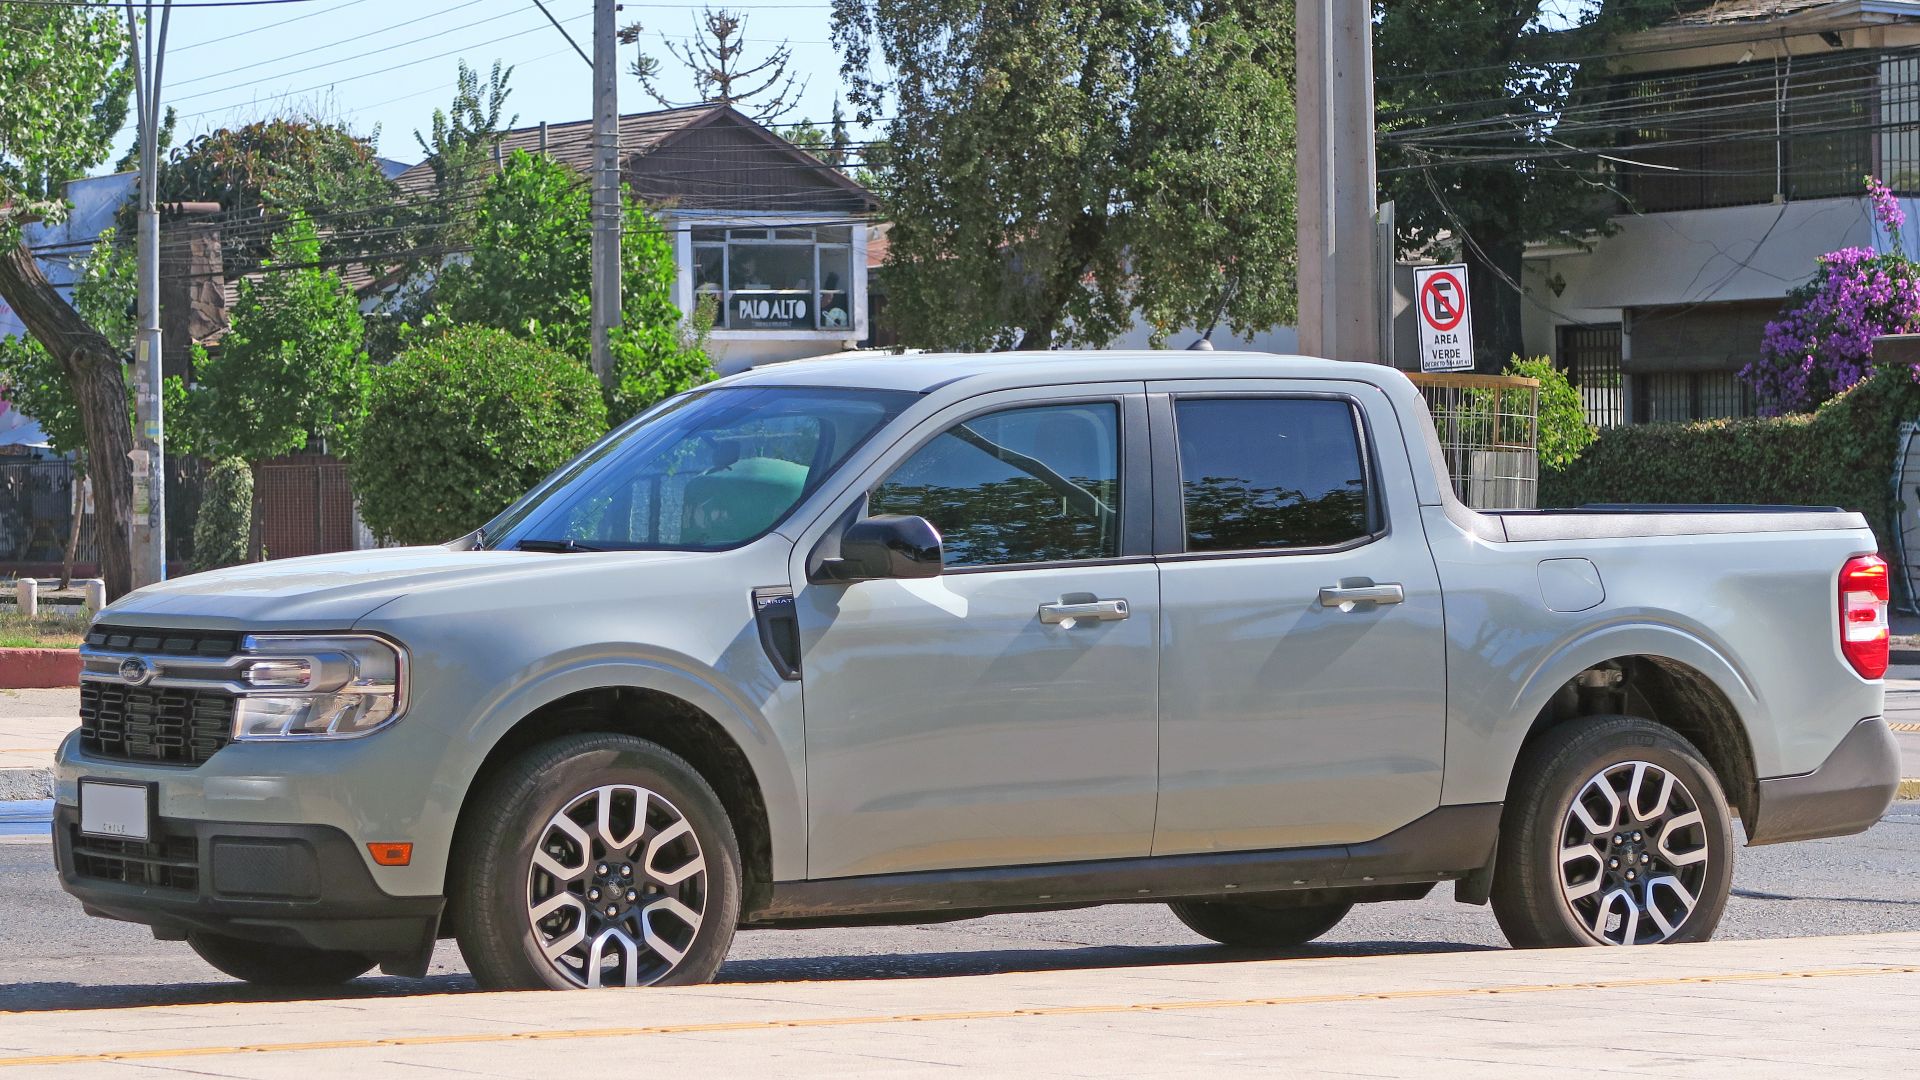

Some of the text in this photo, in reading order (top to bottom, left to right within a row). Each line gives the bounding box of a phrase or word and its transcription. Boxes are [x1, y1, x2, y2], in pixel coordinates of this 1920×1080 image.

[739, 299, 806, 319] PALO ALTO
[1434, 334, 1458, 344] AREA
[1432, 349, 1460, 359] VERDE
